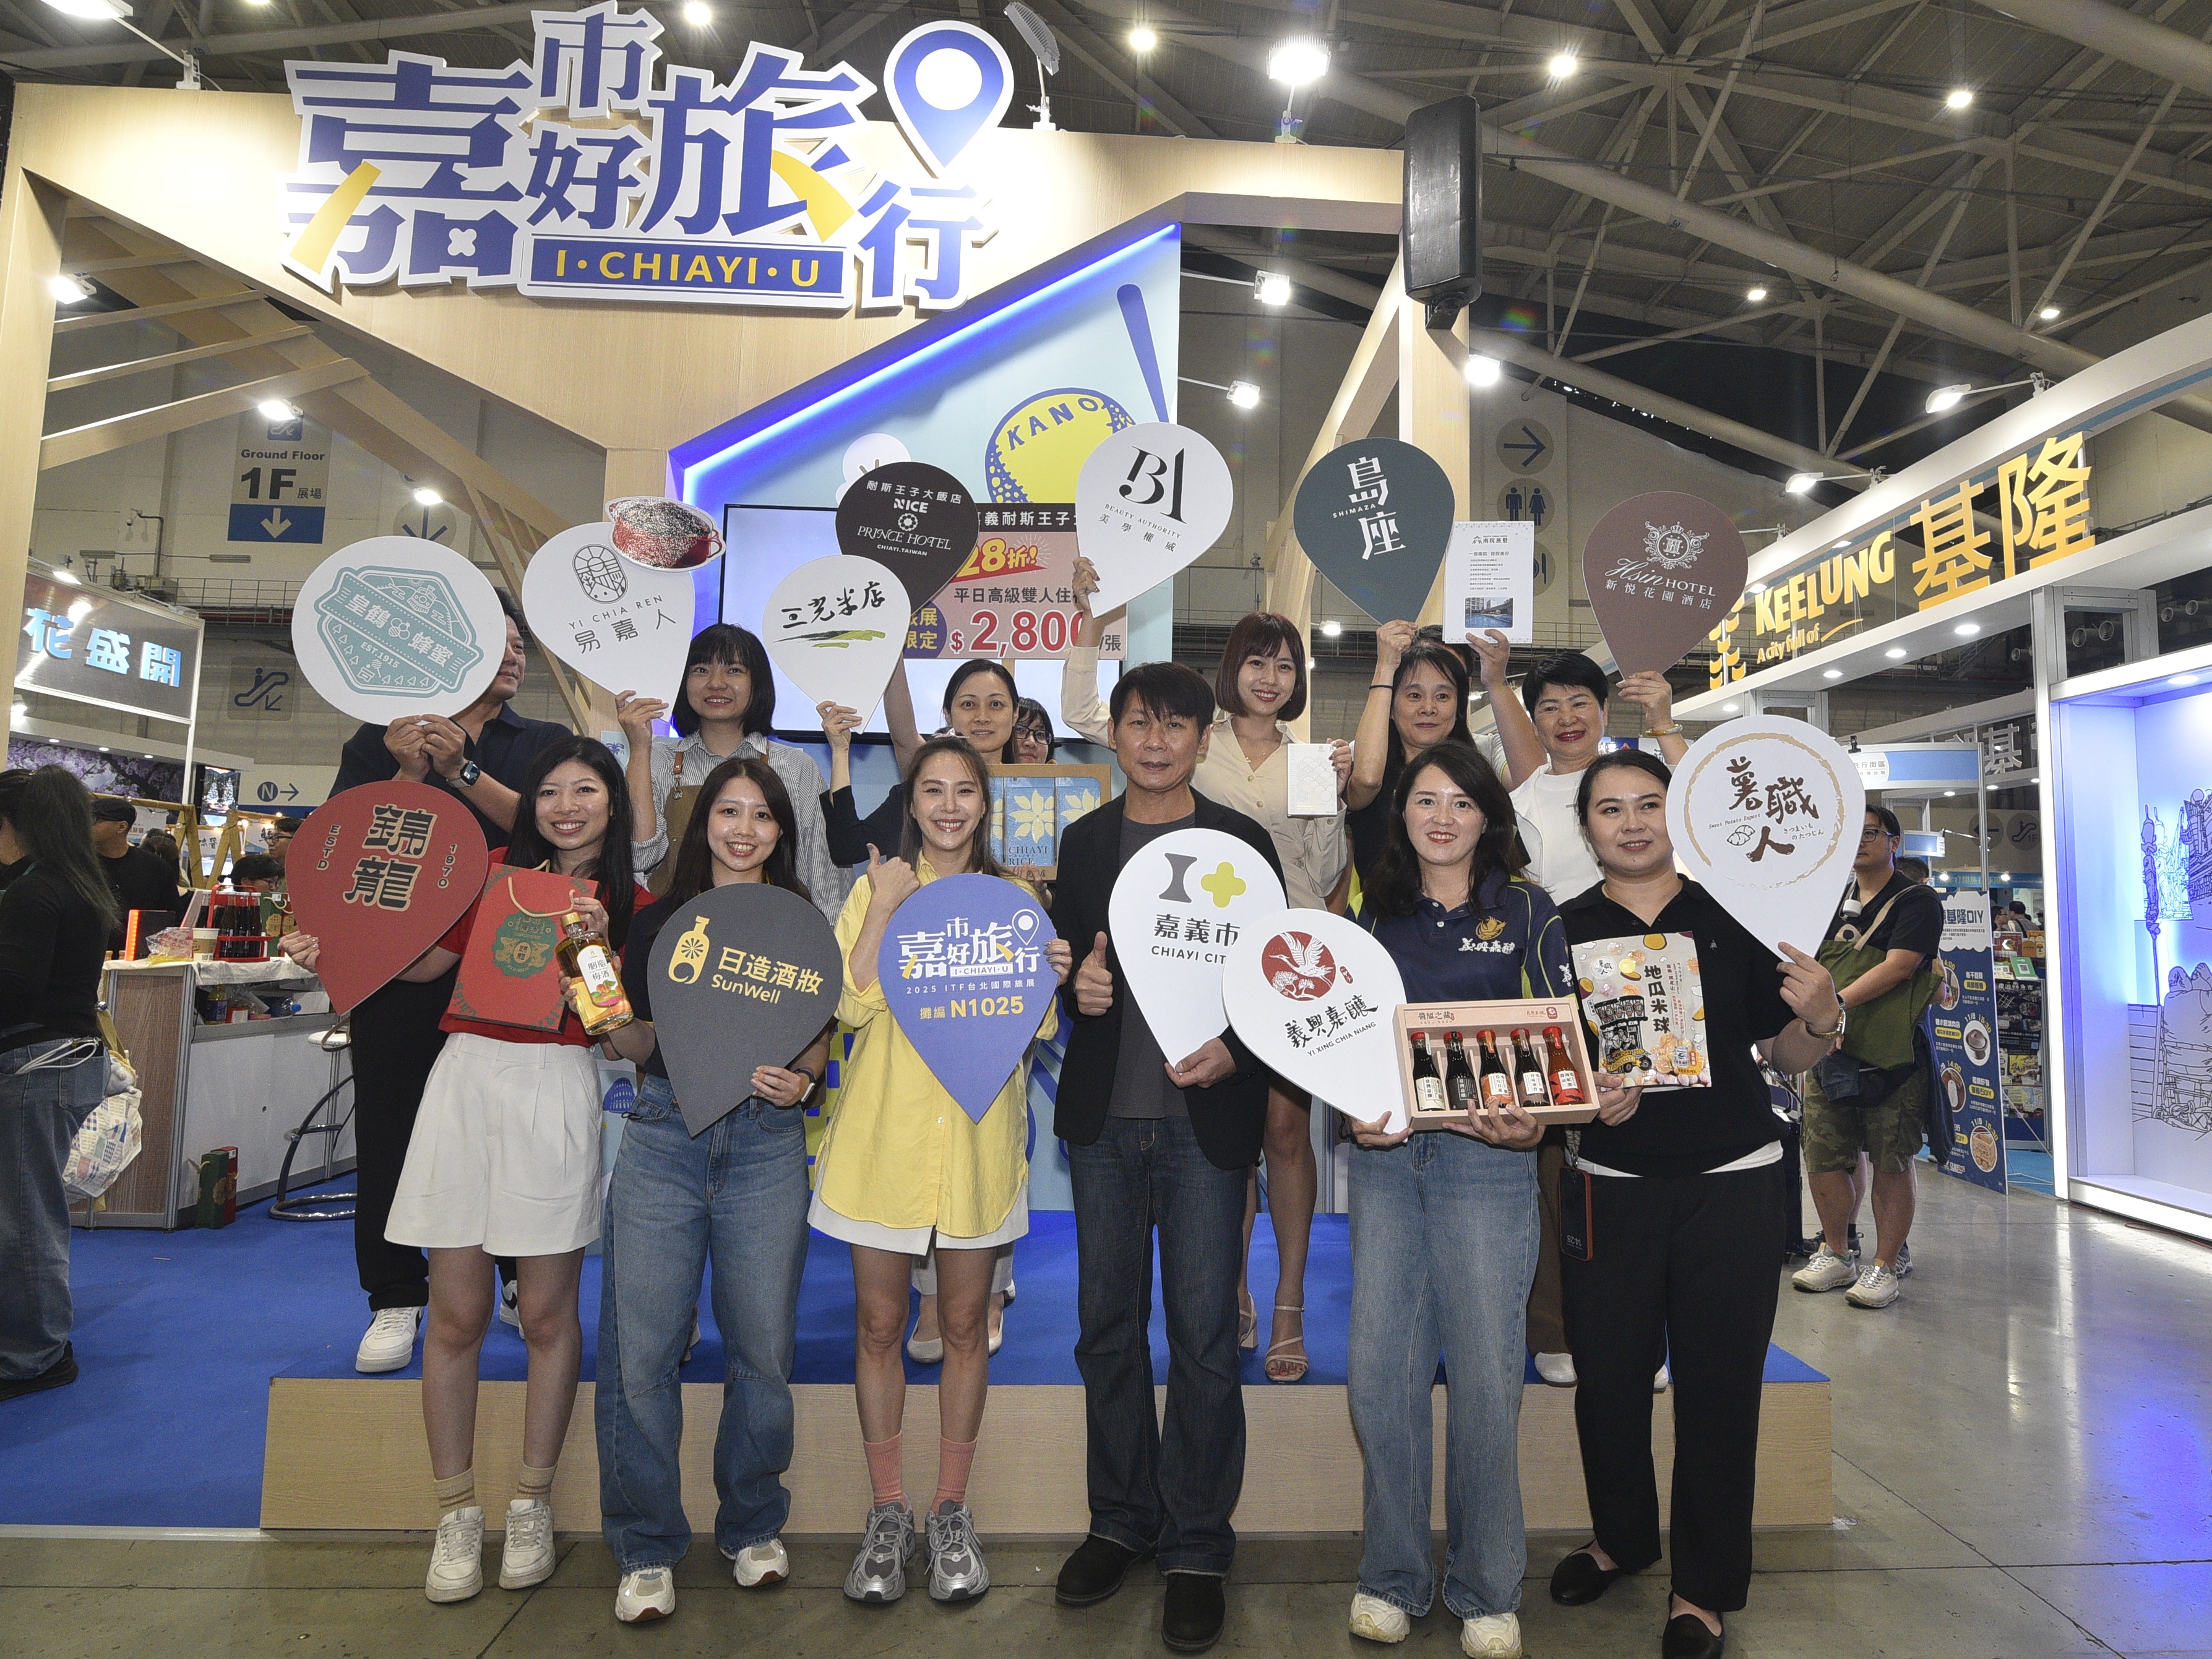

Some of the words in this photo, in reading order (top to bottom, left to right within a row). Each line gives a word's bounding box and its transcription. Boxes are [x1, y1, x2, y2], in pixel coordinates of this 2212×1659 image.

[1007, 397, 1099, 451] KANO
[241, 448, 288, 459] Ground
[292, 450, 325, 460] Floor
[241, 467, 296, 500] 1F
[297, 487, 322, 500] 展場
[866, 480, 962, 504] 耐斯王子大飯店
[893, 498, 929, 513] NICE
[977, 510, 1077, 526] 義耐斯王子
[1104, 504, 1135, 520] BEAUTY
[1137, 518, 1182, 539] AUTHORITY
[1332, 502, 1377, 518] SHIMAZA
[1346, 457, 1406, 560] 島座
[1909, 431, 2096, 611] 基隆
[857, 526, 905, 543] PRINCE
[907, 533, 952, 551] HOTEL
[1098, 513, 1176, 552] 美學權威
[1604, 558, 1664, 586] Hsin
[1666, 578, 1716, 596] HOTEL
[1755, 530, 1895, 637] KEELUNG
[569, 619, 587, 630] YI
[592, 606, 629, 624] CHIA
[635, 594, 664, 610] REN
[345, 594, 392, 628] 皇鶴
[408, 632, 454, 667] 蜂蜜
[574, 608, 677, 654] 易嘉人
[950, 630, 964, 654] $
[1757, 648, 1766, 664] A
[1765, 641, 1784, 660] city
[1785, 628, 1805, 652] full
[1807, 622, 1820, 643] of
[24, 607, 181, 688] 花盛開
[360, 642, 400, 669] EST.1915
[1725, 818, 1742, 826] Potato
[1744, 813, 1760, 821] Expert
[1783, 823, 1814, 834] さつまいも
[1792, 830, 1824, 840] のたつじん
[317, 824, 340, 871] ESTD
[343, 803, 437, 911] 錦龍
[1009, 846, 1048, 854] CHIAYI
[437, 843, 458, 889] 1970
[1154, 914, 1241, 946] 嘉義市
[1151, 945, 1199, 961] CHIAYI
[1204, 953, 1227, 964] CIT
[718, 946, 824, 996] 日造酒妝
[711, 974, 781, 1005] SunWell
[906, 985, 937, 994] 2025
[1644, 964, 1671, 1034] 地瓜米球
[919, 1006, 945, 1019] 攤編
[950, 995, 1024, 1018] N1025
[1316, 1042, 1334, 1053] XING
[1335, 1032, 1353, 1044] CHIA
[1354, 1021, 1377, 1035] NIANG
